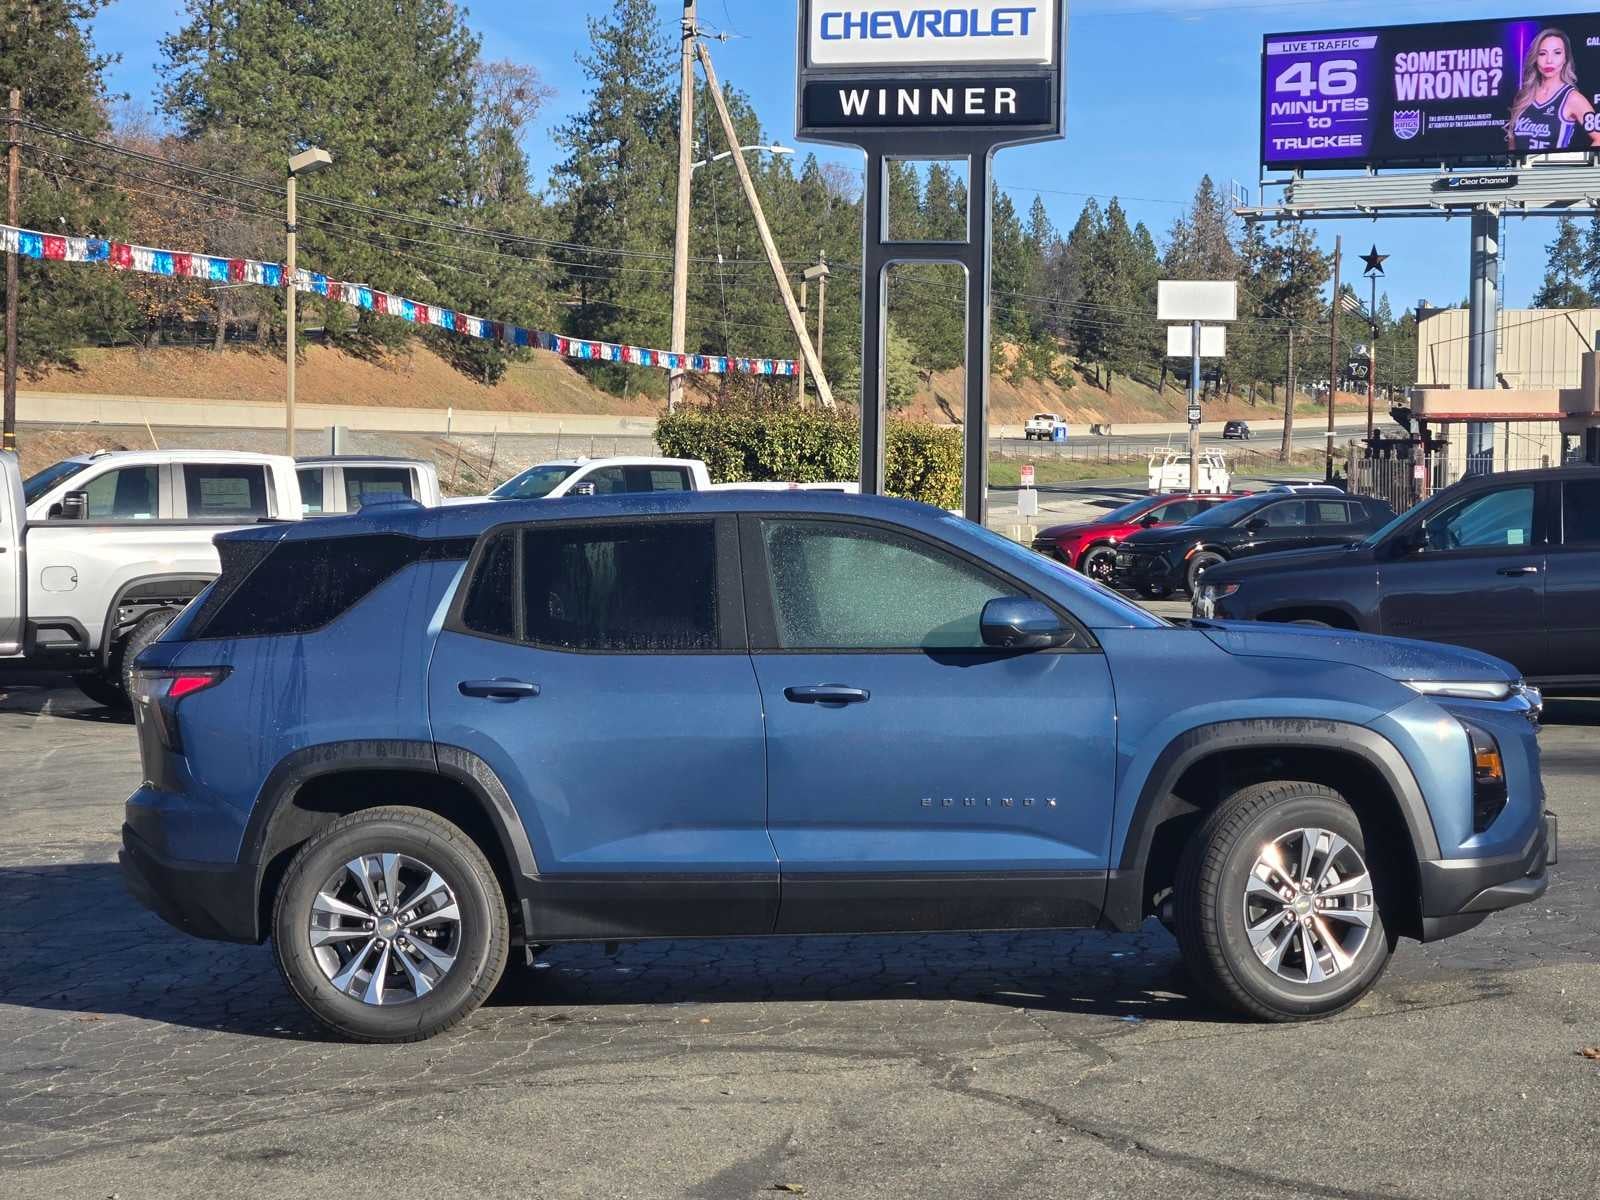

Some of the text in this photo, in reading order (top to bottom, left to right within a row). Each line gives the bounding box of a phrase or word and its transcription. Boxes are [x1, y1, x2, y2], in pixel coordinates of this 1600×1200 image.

[820, 7, 1037, 40] CHEVROLET
[1282, 39, 1360, 52] LIVE TRAFFIC
[1394, 47, 1503, 73] SOMETHING
[1275, 59, 1358, 97] 46
[1394, 68, 1503, 101] WRONG?
[839, 87, 1017, 116] WINNER
[1271, 97, 1369, 115] MINUTES
[1307, 115, 1332, 128] to
[1513, 117, 1550, 138] Kings
[1272, 134, 1363, 150] TRUCKEE
[1459, 176, 1509, 186] Clear Channel
[920, 797, 1057, 808] EQUINOX
